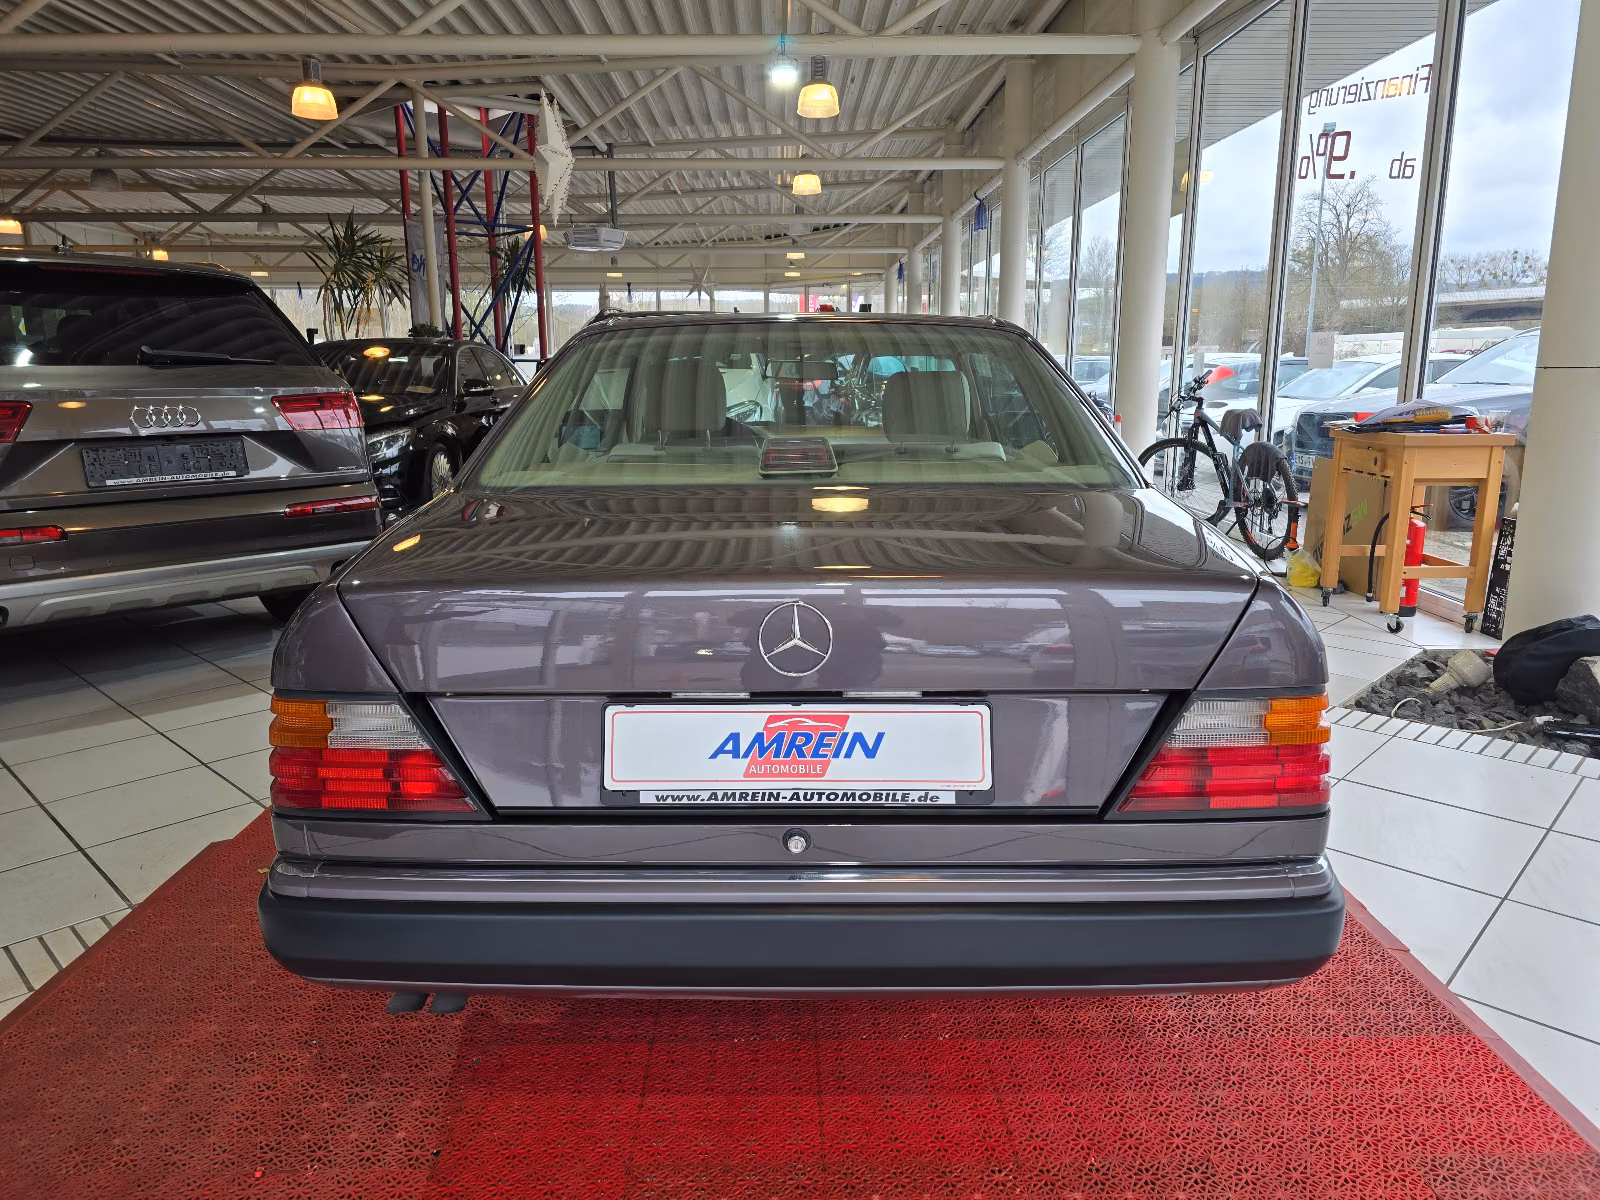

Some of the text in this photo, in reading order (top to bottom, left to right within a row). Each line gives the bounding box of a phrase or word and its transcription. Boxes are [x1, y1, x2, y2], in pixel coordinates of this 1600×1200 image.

[708, 731, 885, 759] AMREIN
[749, 764, 823, 774] AUTOMOBILE
[655, 791, 940, 803] www.AMREIN-AUTOMOBILE.de
